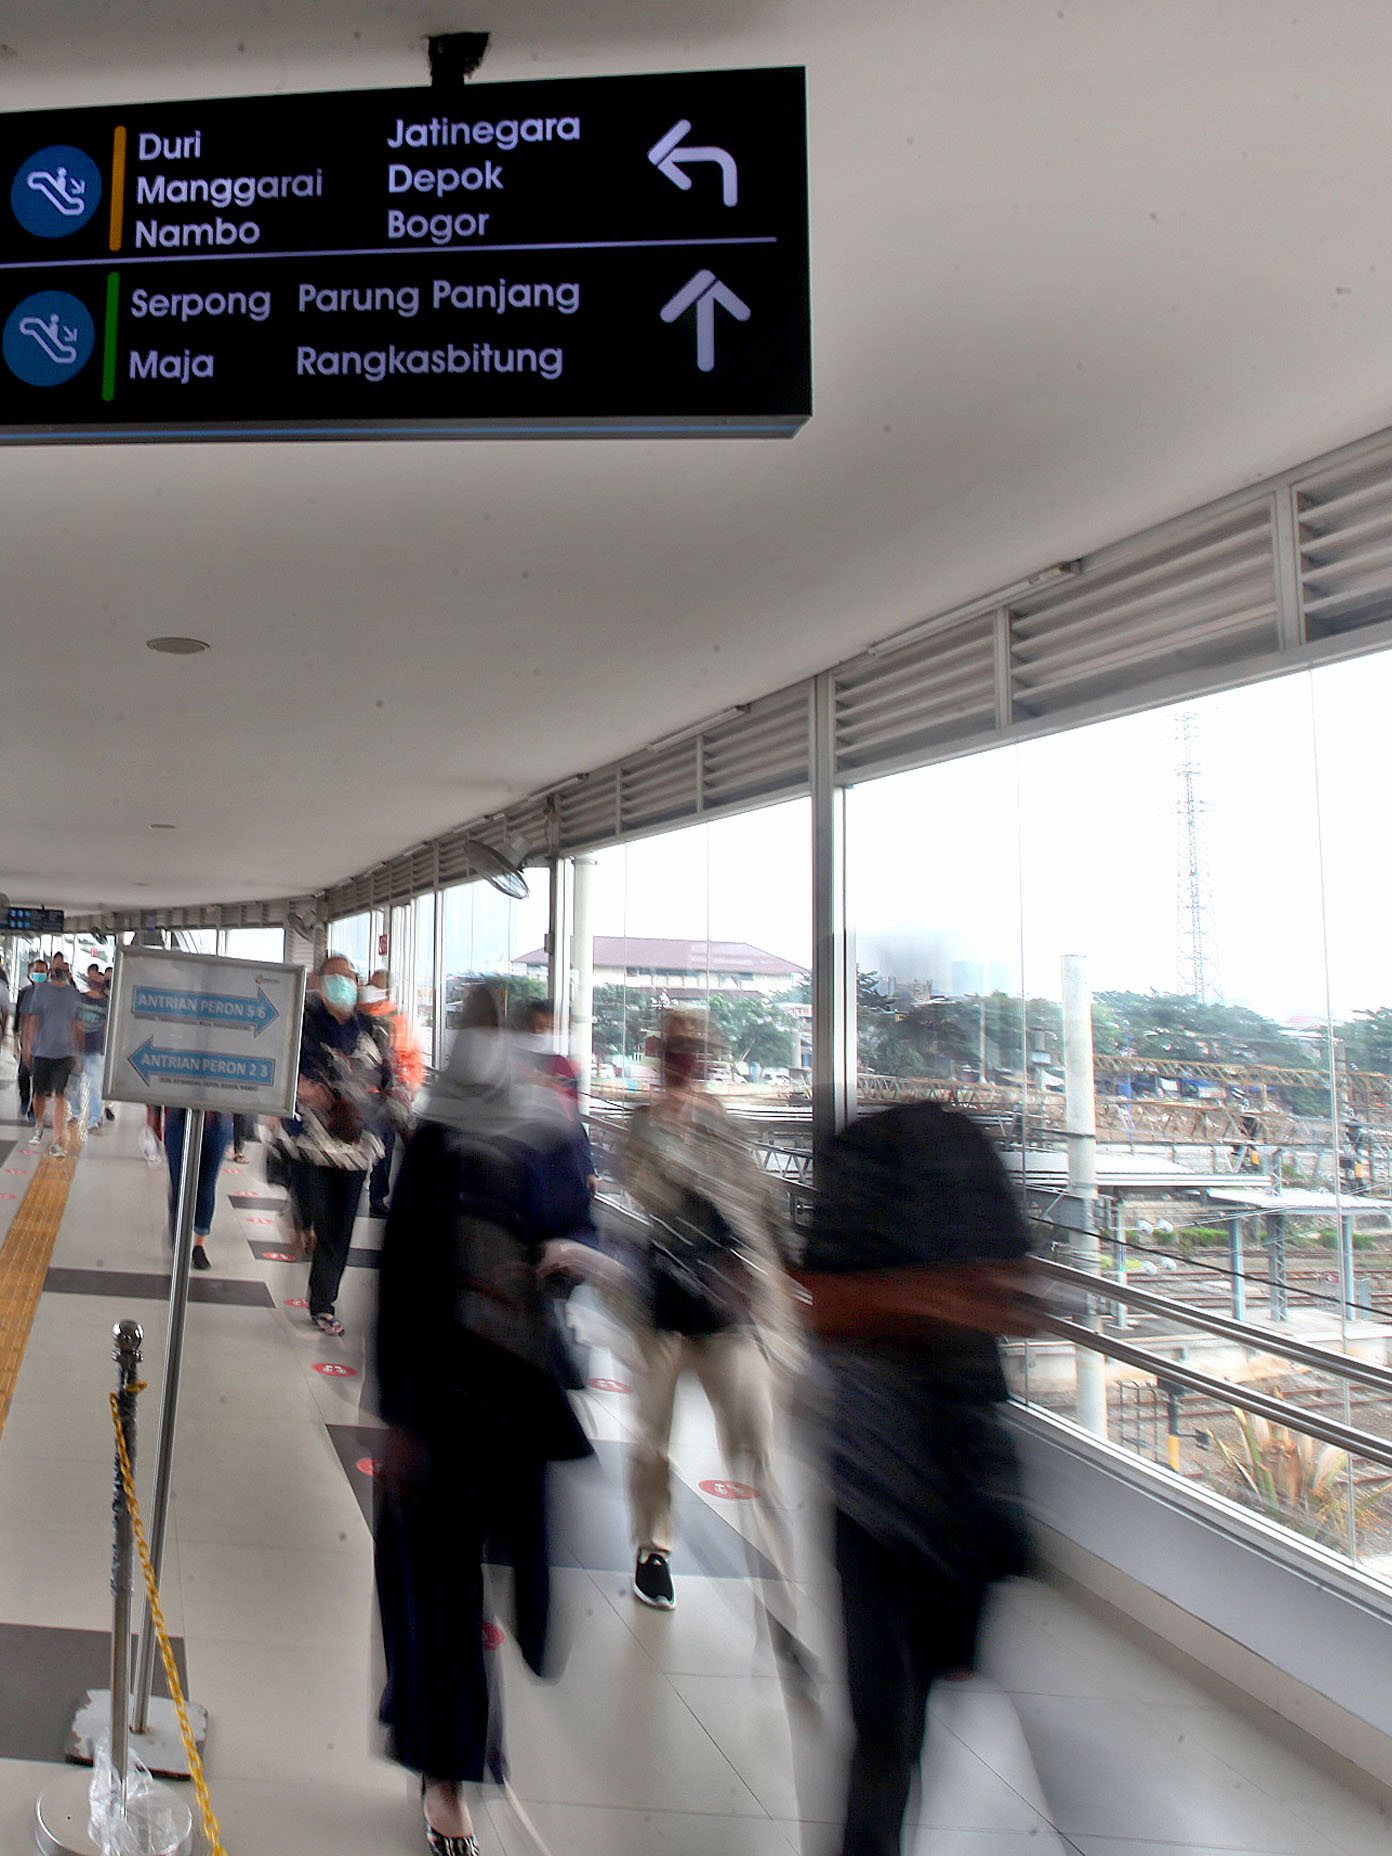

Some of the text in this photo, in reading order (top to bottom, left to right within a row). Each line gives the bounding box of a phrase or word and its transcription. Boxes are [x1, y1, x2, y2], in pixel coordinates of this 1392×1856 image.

[138, 130, 201, 161] Duri
[387, 116, 581, 150] Jatinegara
[136, 169, 323, 208] Manggarai
[388, 160, 504, 197] Depok
[135, 217, 260, 248] Nambo
[388, 209, 490, 245] Bogor
[131, 289, 271, 321] Serpong
[298, 278, 580, 319] Parung Panjang
[129, 349, 214, 384] Maja
[297, 343, 563, 382] Rangkasbitung
[138, 993, 199, 1011] ANTRIAN
[200, 1000, 244, 1016] PERON
[141, 1053, 268, 1078] ANTRIAN PERON 2 3
